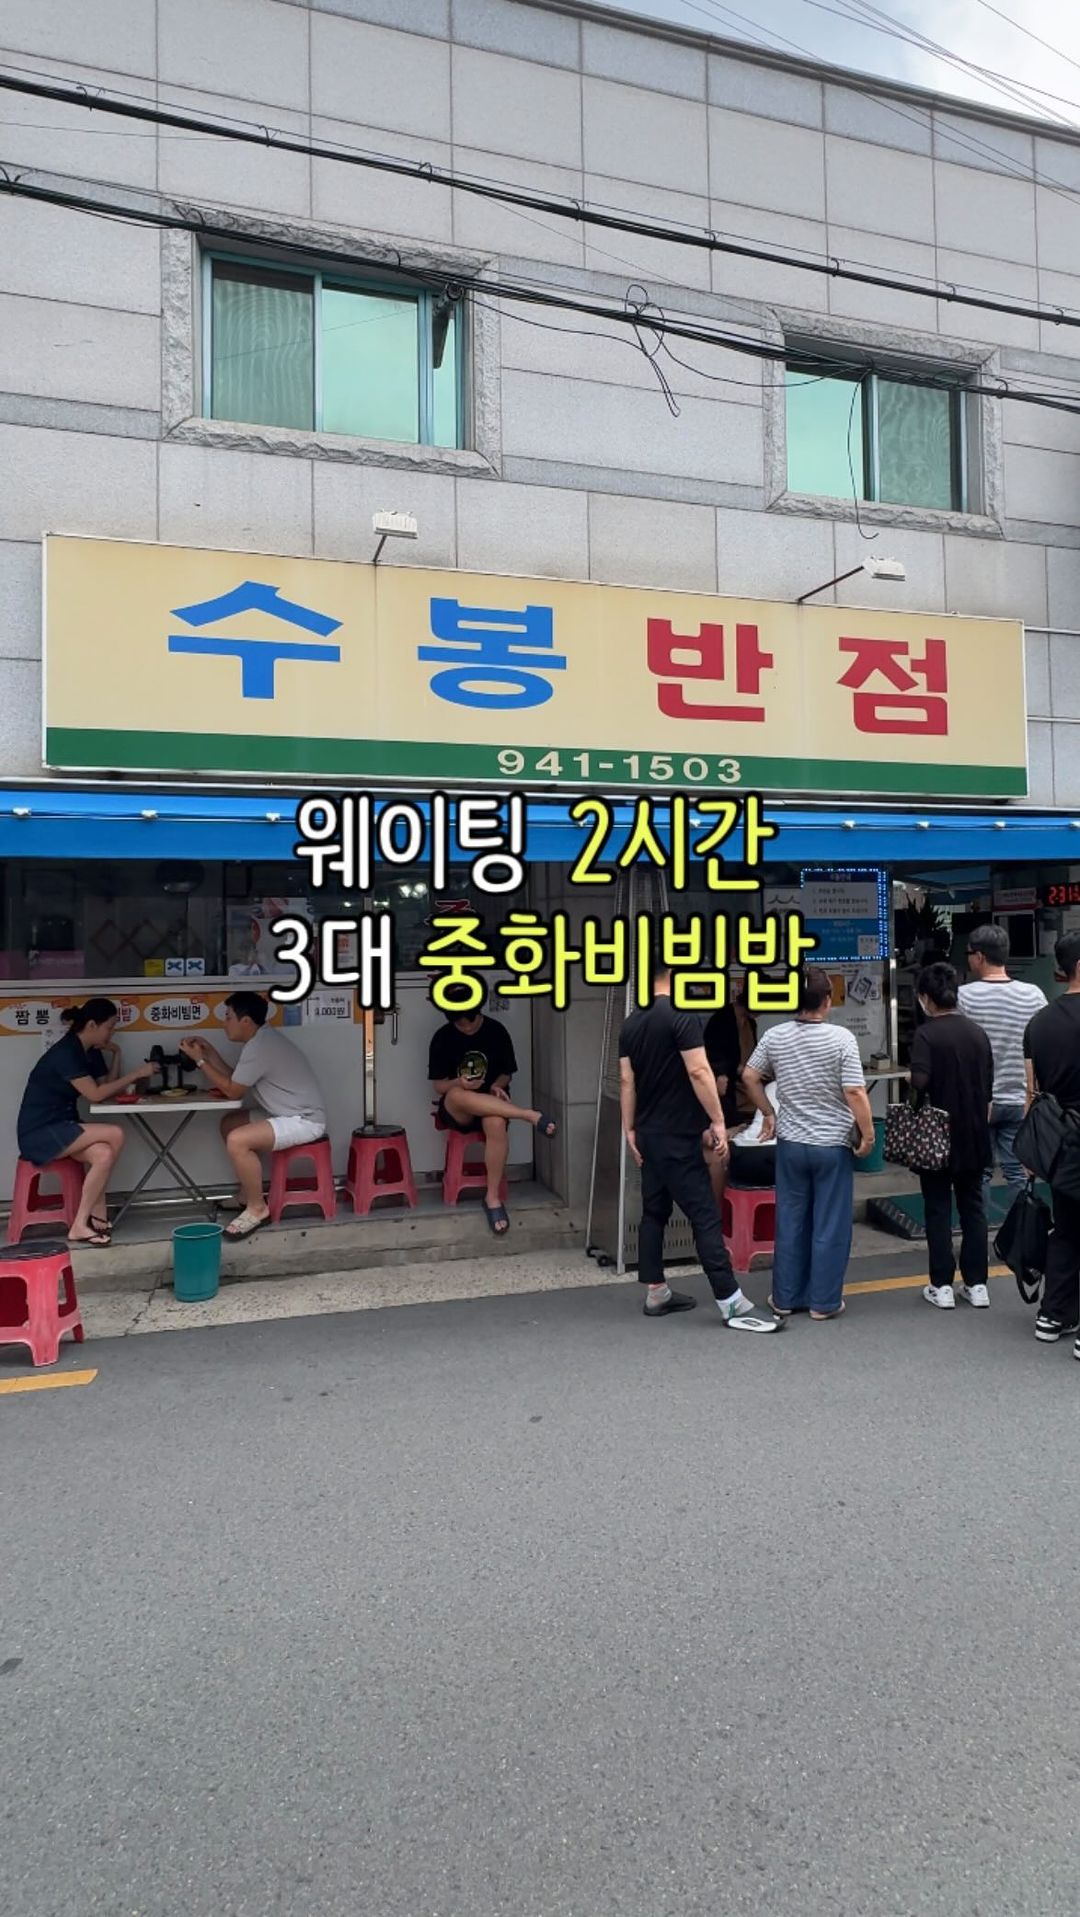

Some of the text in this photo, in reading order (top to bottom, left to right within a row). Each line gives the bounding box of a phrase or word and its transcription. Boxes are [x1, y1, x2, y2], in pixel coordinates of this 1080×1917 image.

[168, 581, 948, 735] 수봉반점
[496, 749, 742, 783] 941-1503
[15, 1008, 50, 1025] 짬뽕
[150, 1005, 202, 1021] 중화비빔면
